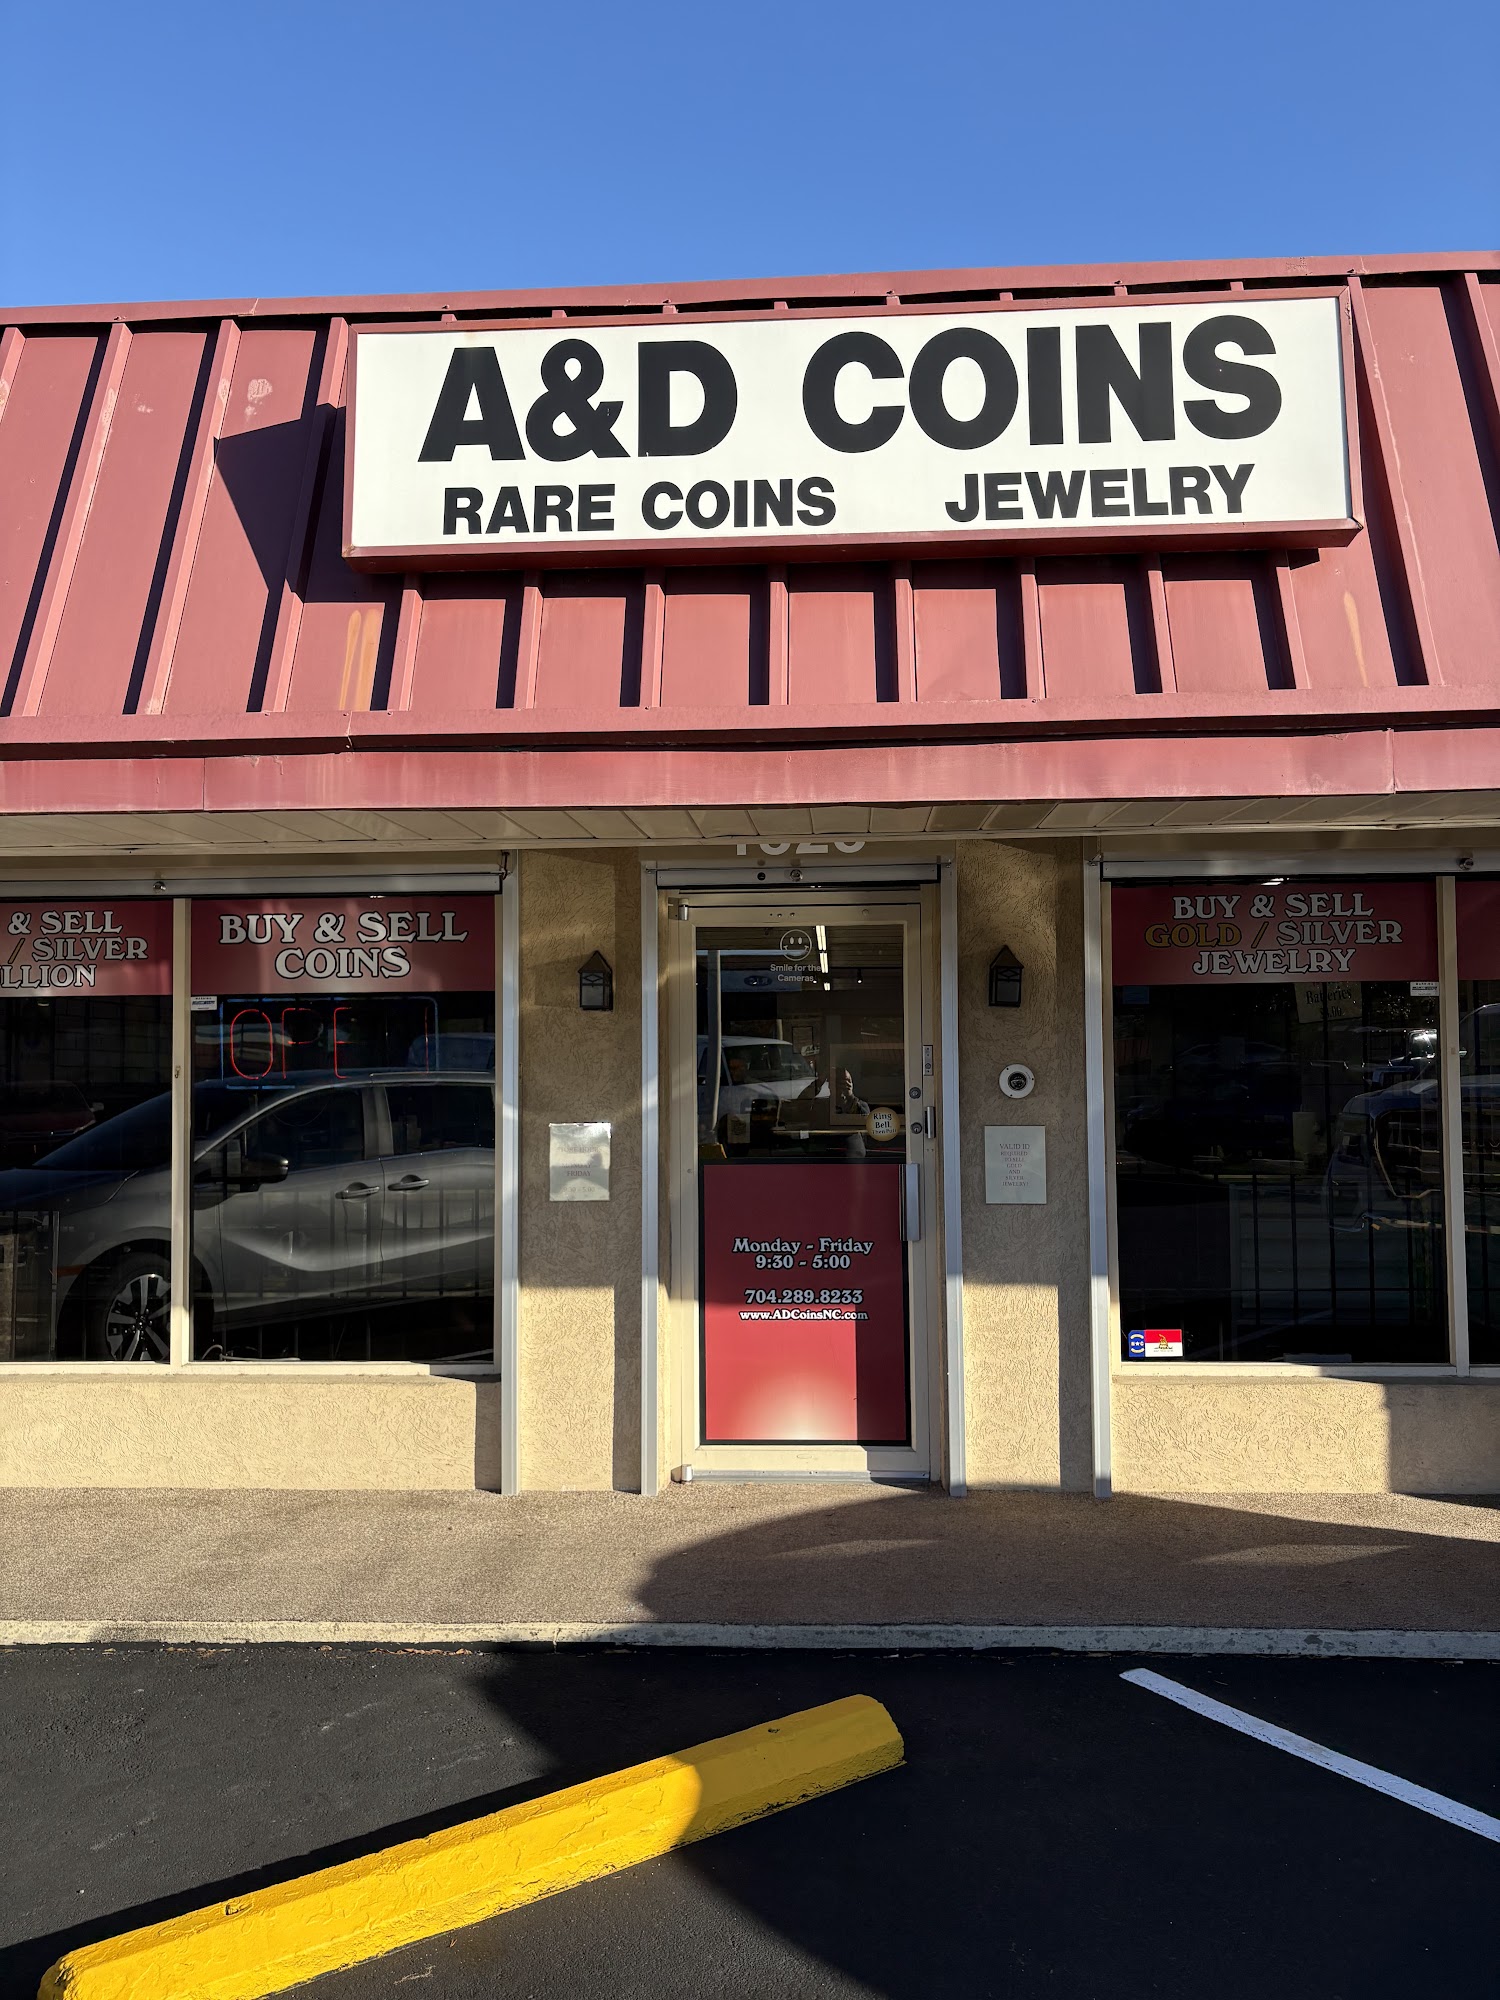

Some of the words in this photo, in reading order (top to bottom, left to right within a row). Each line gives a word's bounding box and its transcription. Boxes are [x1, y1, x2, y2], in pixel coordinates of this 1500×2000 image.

[416, 337, 739, 464] A&D
[802, 314, 1282, 454] COINS
[442, 482, 616, 537] RARE
[641, 475, 836, 532] COINS
[945, 463, 1255, 524] JEWELRY
[1173, 895, 1241, 920] BUY
[1250, 894, 1275, 918] &
[1284, 893, 1374, 918] SELL
[8, 912, 31, 934] &
[40, 911, 123, 935] SELL
[219, 912, 304, 945] BUY
[313, 913, 346, 944] &
[356, 910, 469, 944] SELL
[1144, 922, 1243, 948] GOLD
[1277, 919, 1403, 946] SILVER
[32, 936, 149, 962] SILVER
[274, 945, 411, 979] COINS
[770, 963, 793, 972] Smile
[794, 963, 807, 972] for
[807, 963, 822, 972] the
[1192, 949, 1356, 976] JEWELRY
[0, 964, 97, 989] LLION
[732, 1238, 802, 1254] Monday
[818, 1238, 874, 1254] Friday
[755, 1254, 794, 1269] 9:30
[812, 1254, 851, 1269] 5:00
[744, 1289, 864, 1304] 704.289.8233
[739, 1309, 869, 1320] www.ADCoinsNC.com
